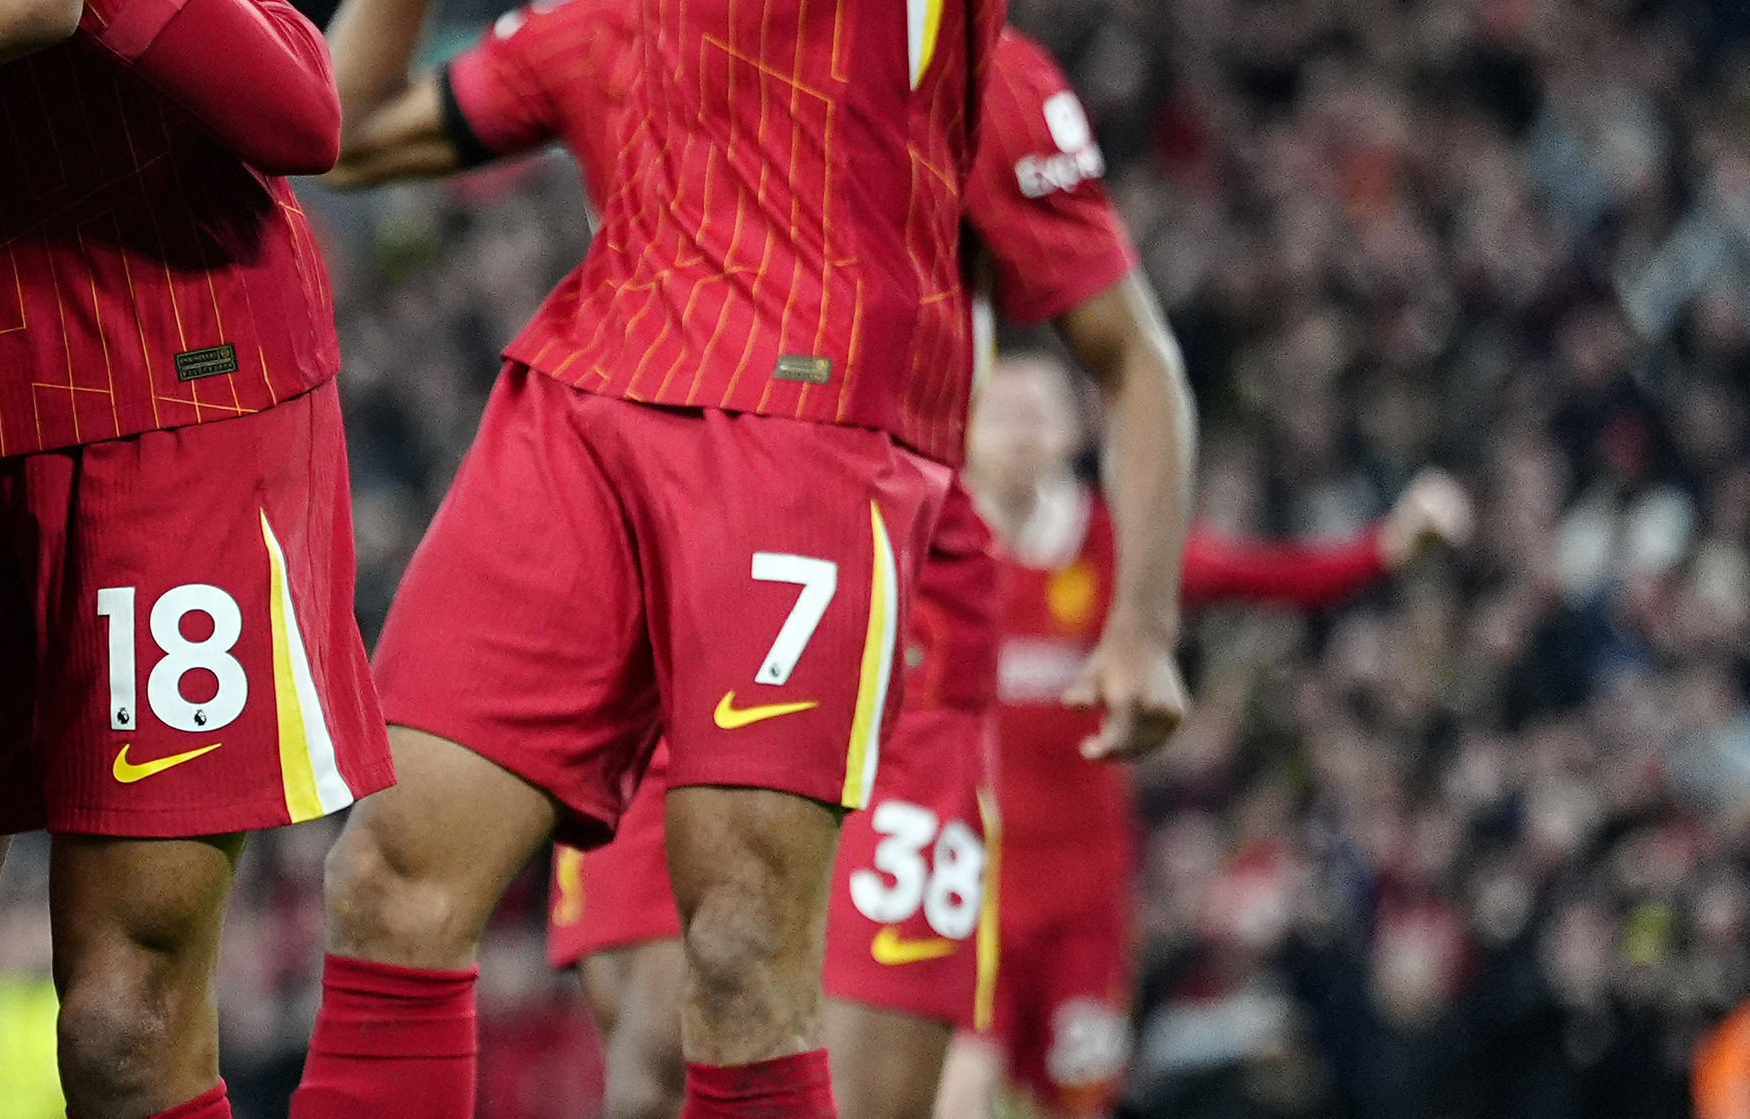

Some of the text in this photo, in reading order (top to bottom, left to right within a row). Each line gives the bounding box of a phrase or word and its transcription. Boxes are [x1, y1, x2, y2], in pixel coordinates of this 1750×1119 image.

[97, 583, 249, 734] 18
[751, 552, 837, 686] 7
[849, 800, 985, 940] 38
